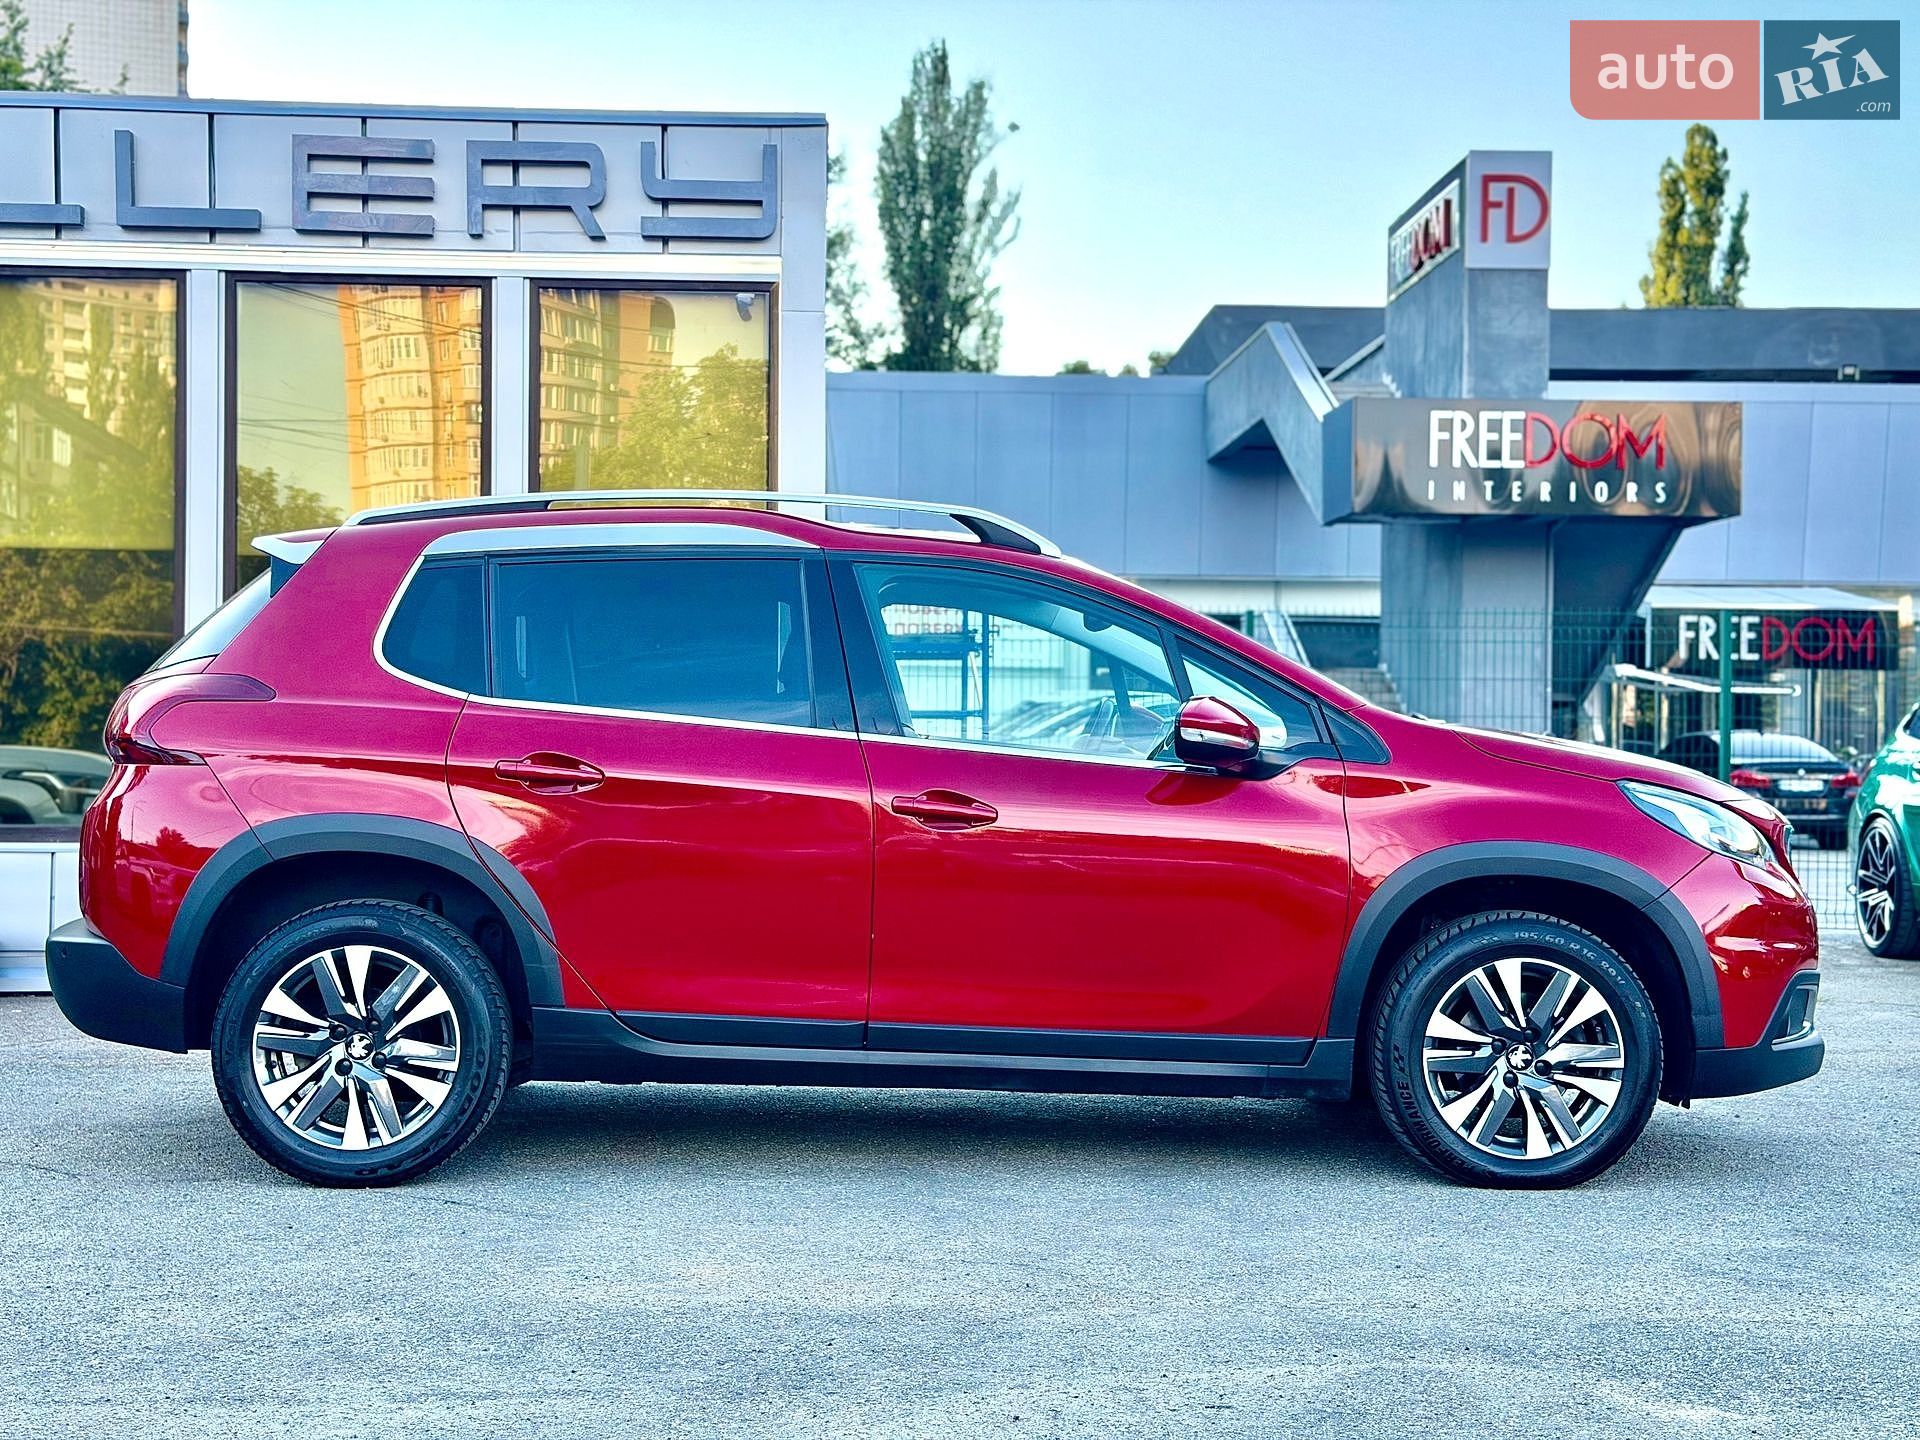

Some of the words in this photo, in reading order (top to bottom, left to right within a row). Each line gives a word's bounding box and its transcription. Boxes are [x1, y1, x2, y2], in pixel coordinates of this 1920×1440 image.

[1480, 173, 1550, 244] FD
[1428, 409, 1667, 471] FREEDOM
[1427, 479, 1667, 504] INTERIORS
[1514, 931, 1565, 945] 195/60
